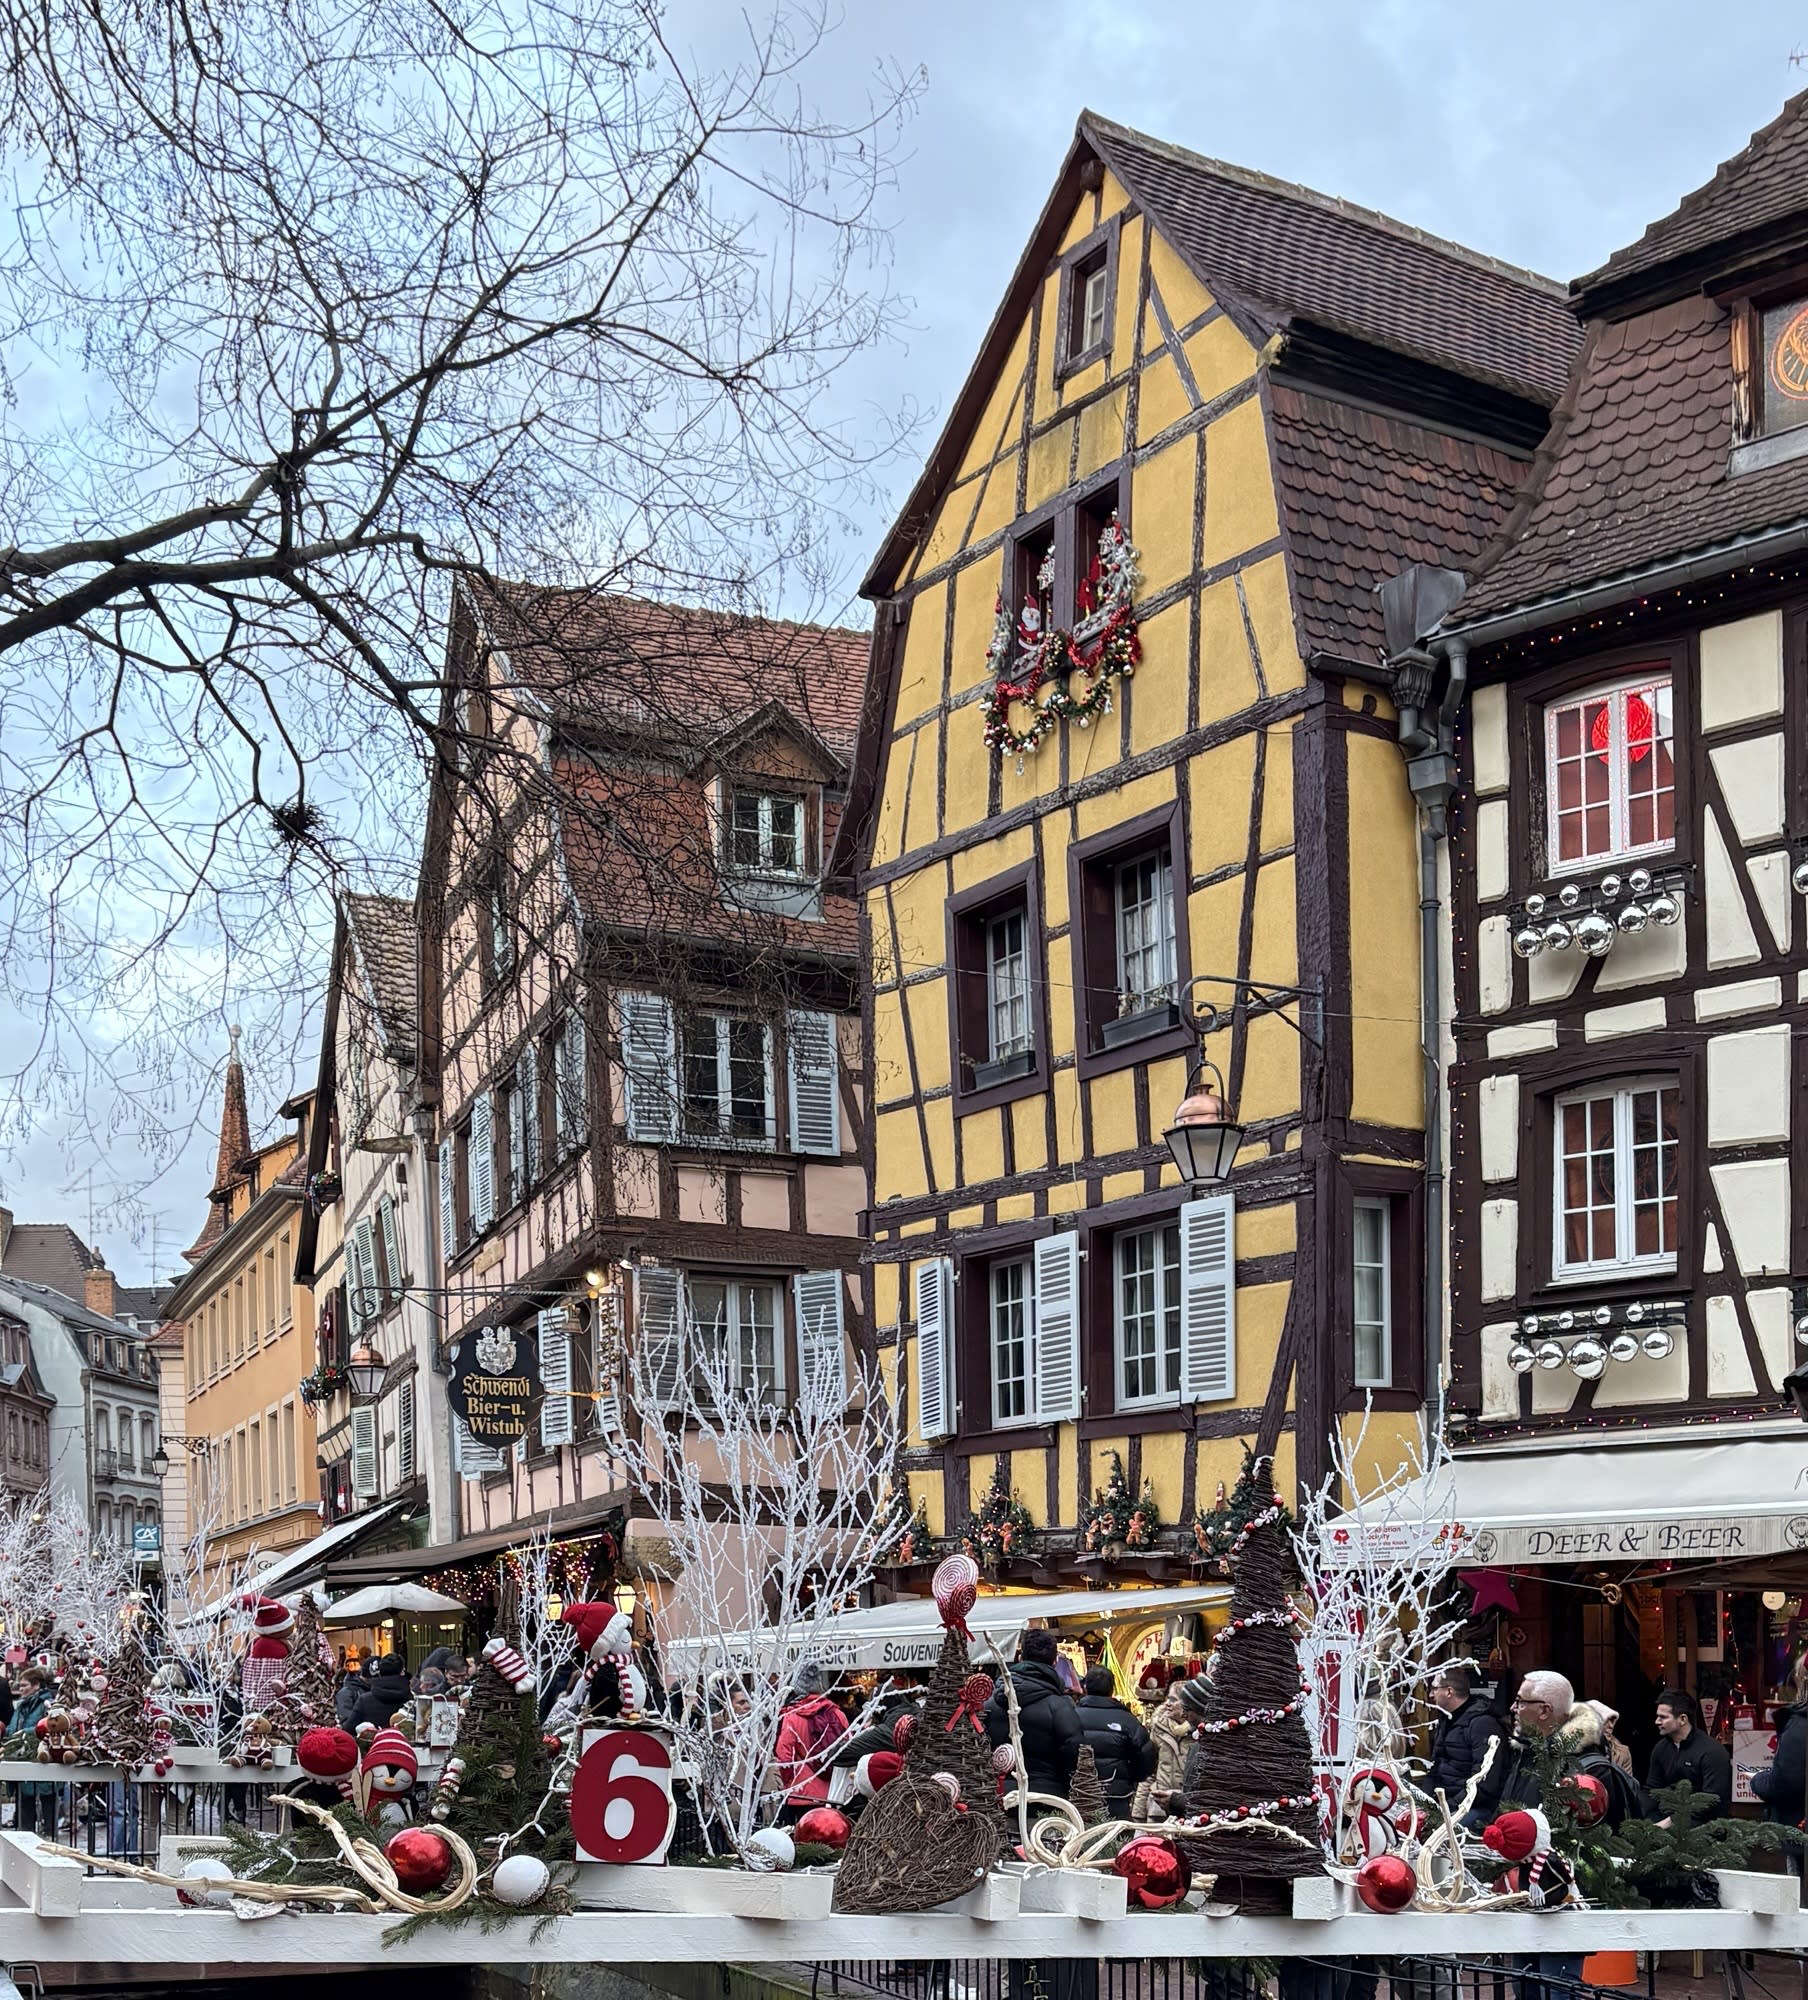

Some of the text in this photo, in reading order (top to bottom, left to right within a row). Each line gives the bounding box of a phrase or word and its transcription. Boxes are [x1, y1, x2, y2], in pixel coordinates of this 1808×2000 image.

[462, 1373, 530, 1396] Schwendi
[469, 1417, 525, 1435] Wistub
[1528, 1525, 1746, 1555] DEER & BEER
[571, 1730, 672, 1863] 6
